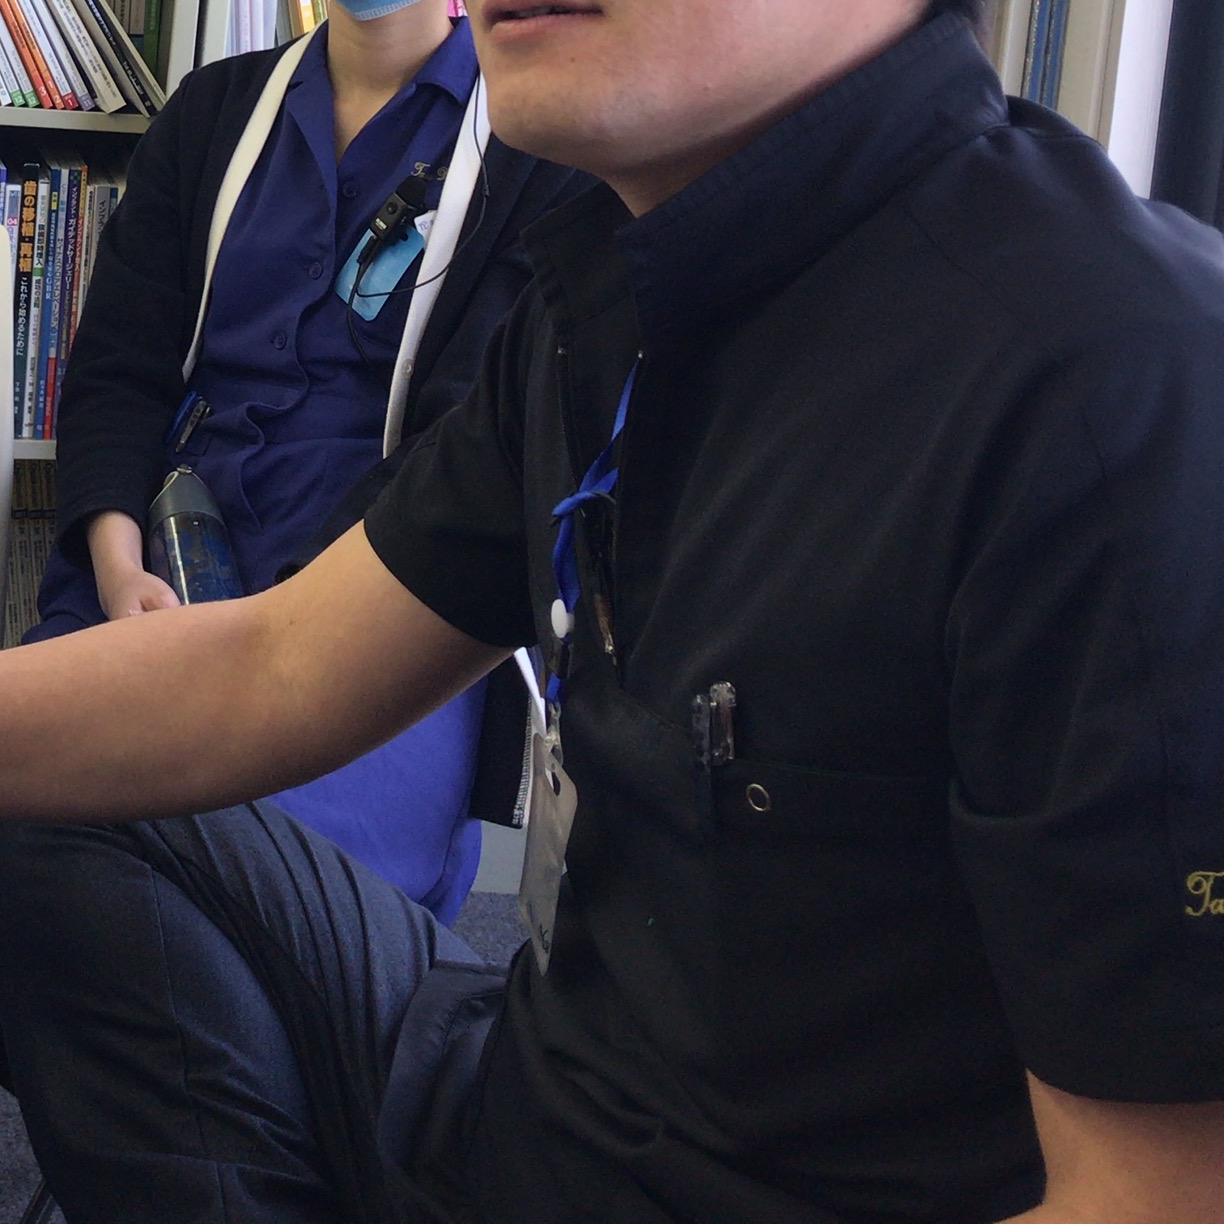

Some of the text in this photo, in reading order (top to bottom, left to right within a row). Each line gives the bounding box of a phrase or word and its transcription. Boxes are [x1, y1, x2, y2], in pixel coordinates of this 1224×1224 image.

[19, 179, 38, 273] 歯の移植・再植
